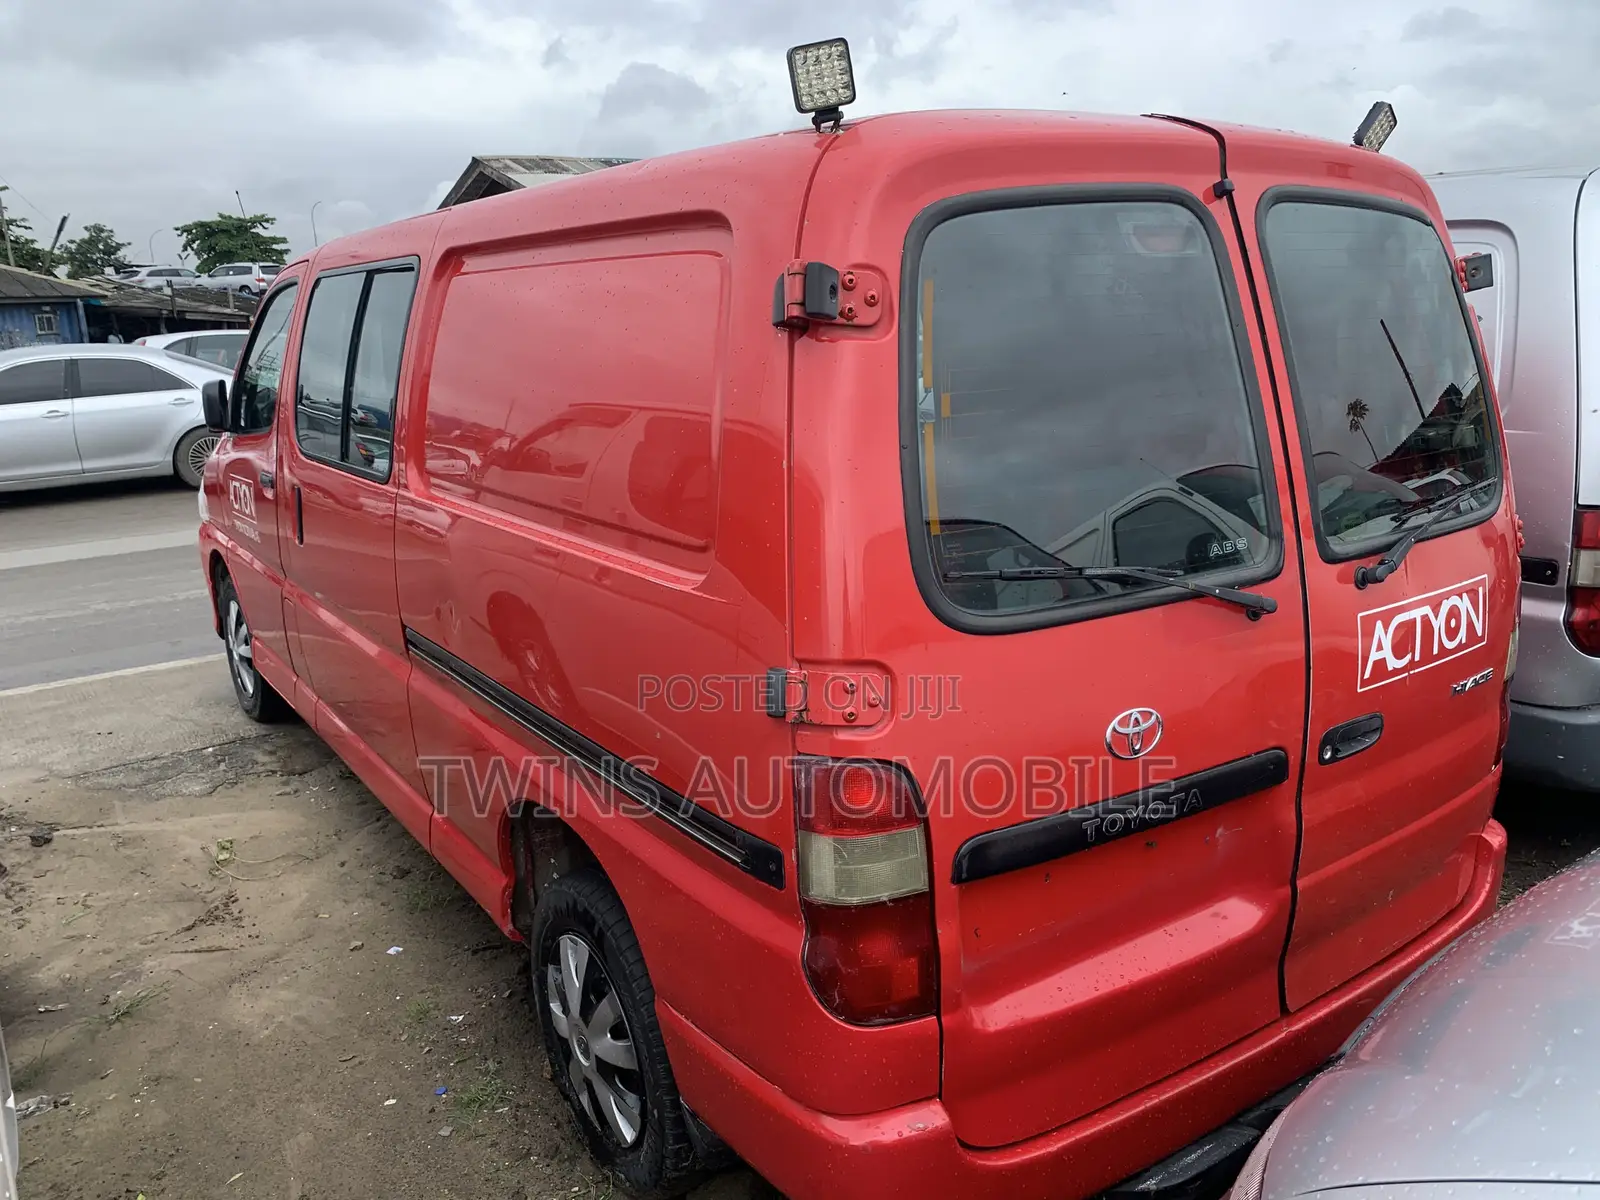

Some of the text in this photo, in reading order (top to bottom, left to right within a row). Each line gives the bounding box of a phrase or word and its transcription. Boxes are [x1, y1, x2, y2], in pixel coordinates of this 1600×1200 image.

[1209, 537, 1248, 556] ABS
[1363, 586, 1483, 680] ACTYON
[1081, 788, 1204, 842] TOYOTA
